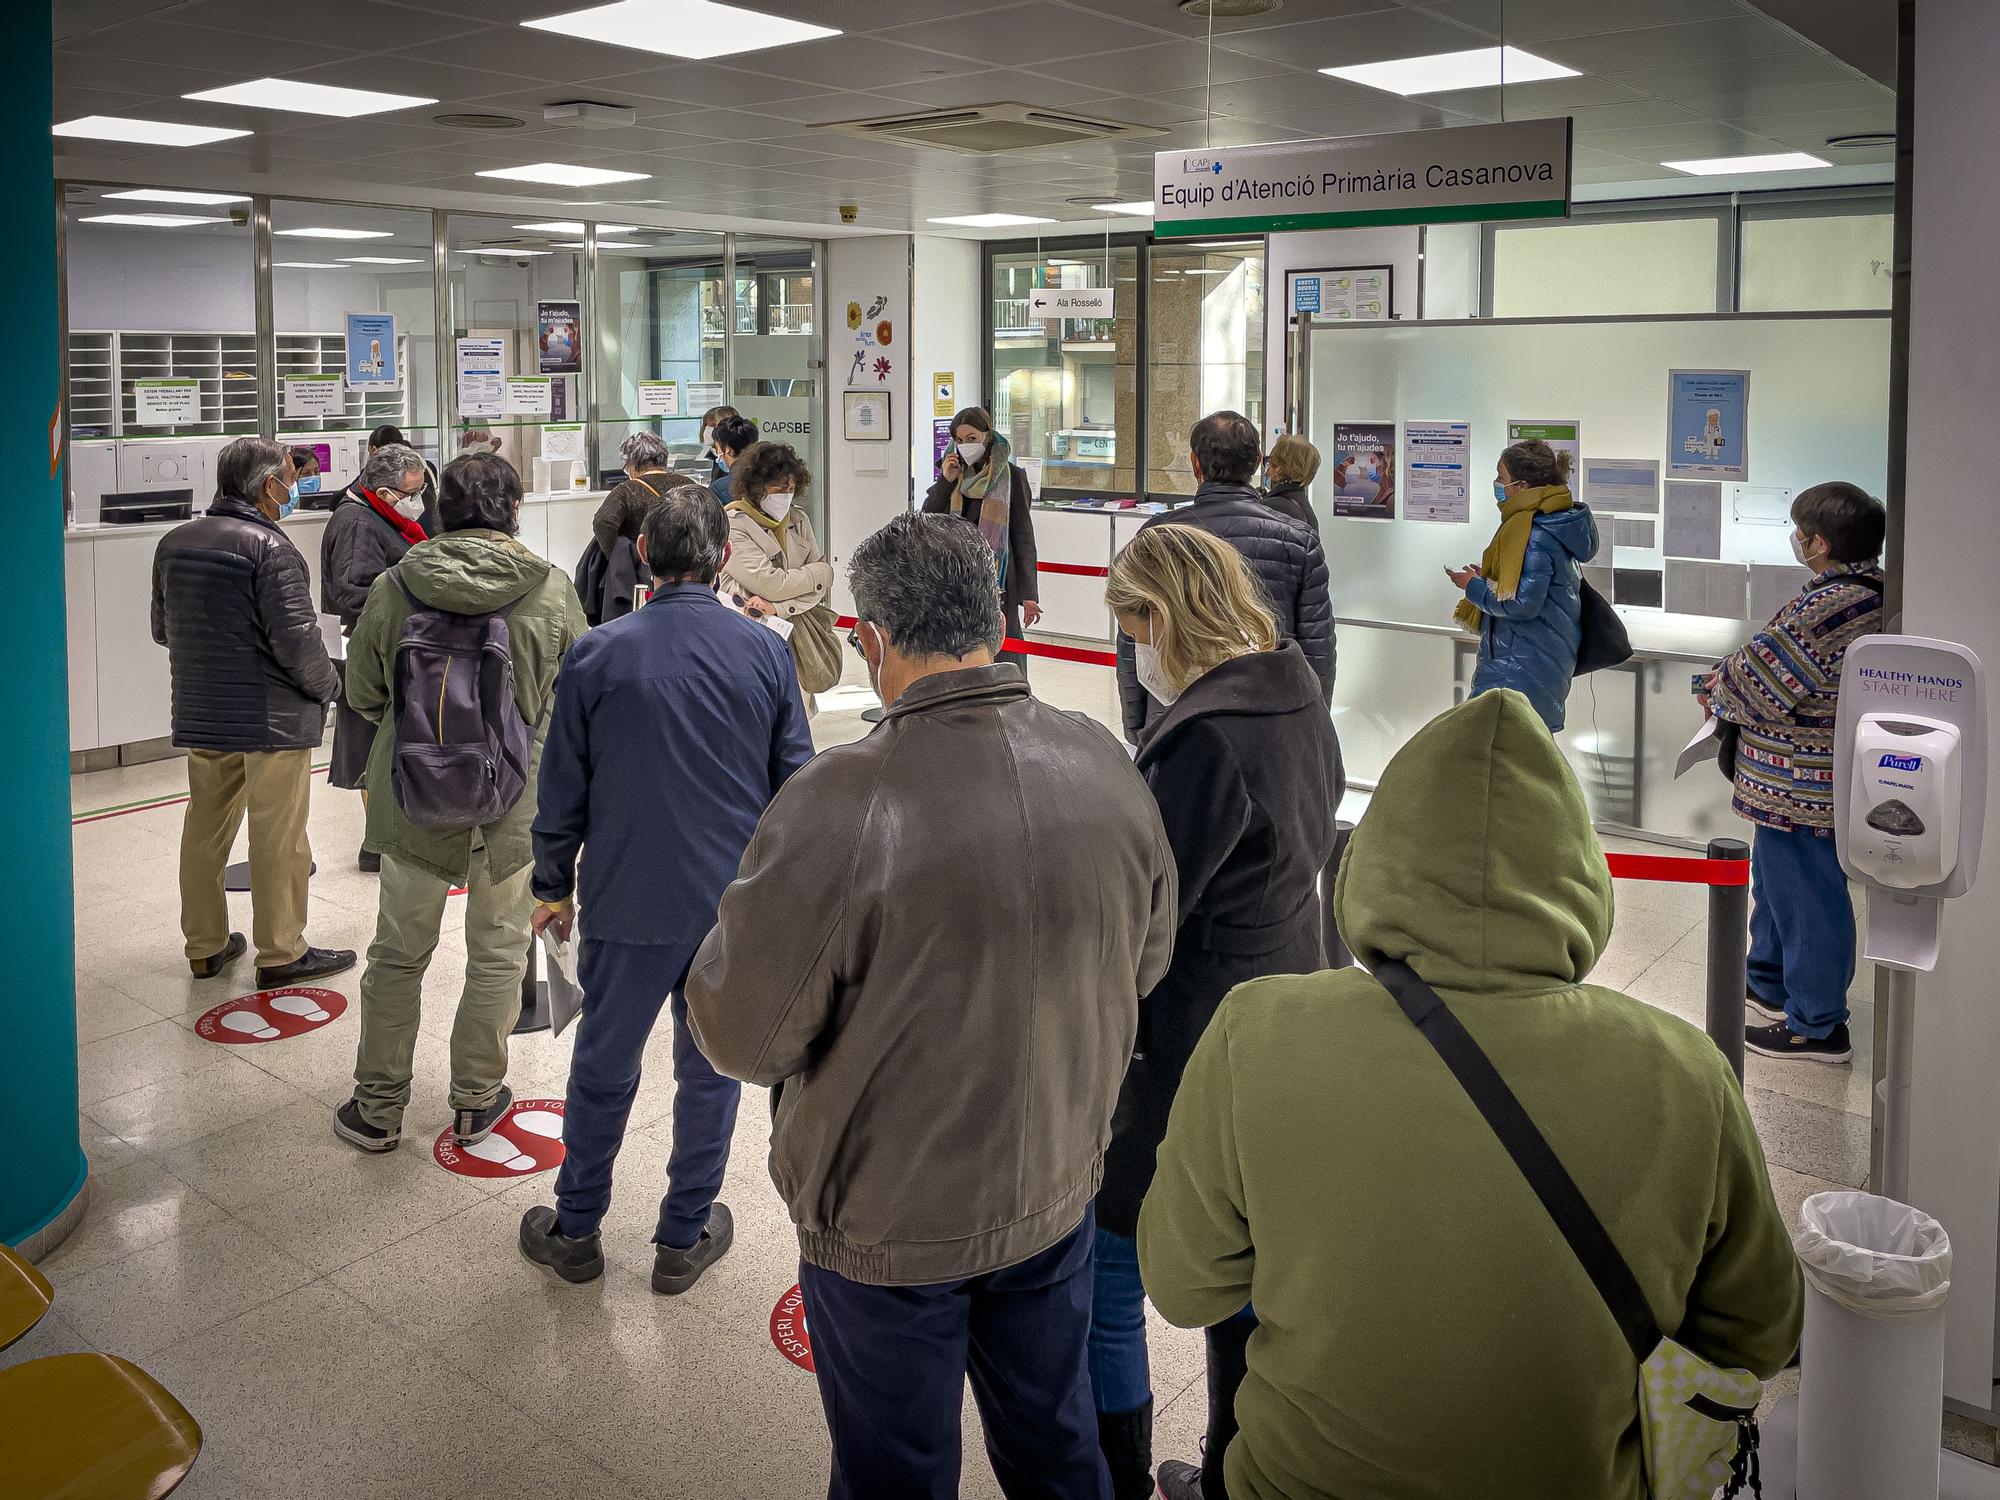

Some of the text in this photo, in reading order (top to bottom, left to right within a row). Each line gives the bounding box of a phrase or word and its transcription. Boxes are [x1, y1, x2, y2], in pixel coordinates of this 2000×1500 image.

[1162, 161, 1553, 208] Equip d'Atenció Primària Casanova
[1057, 298, 1103, 307] Ala Rosselló
[762, 421, 811, 434] CAPSBE
[1337, 433, 1379, 443] Jo t'ajudo,
[1348, 444, 1384, 453] m'ajudes
[1859, 668, 1963, 689] HEALTHY HANDS
[1862, 680, 1958, 703] START HERE
[1884, 755, 1917, 771] Purell
[266, 989, 294, 997] SEU
[440, 1140, 460, 1165] ESPERI
[512, 1102, 536, 1110] EU
[777, 1318, 809, 1358] ESPERI
